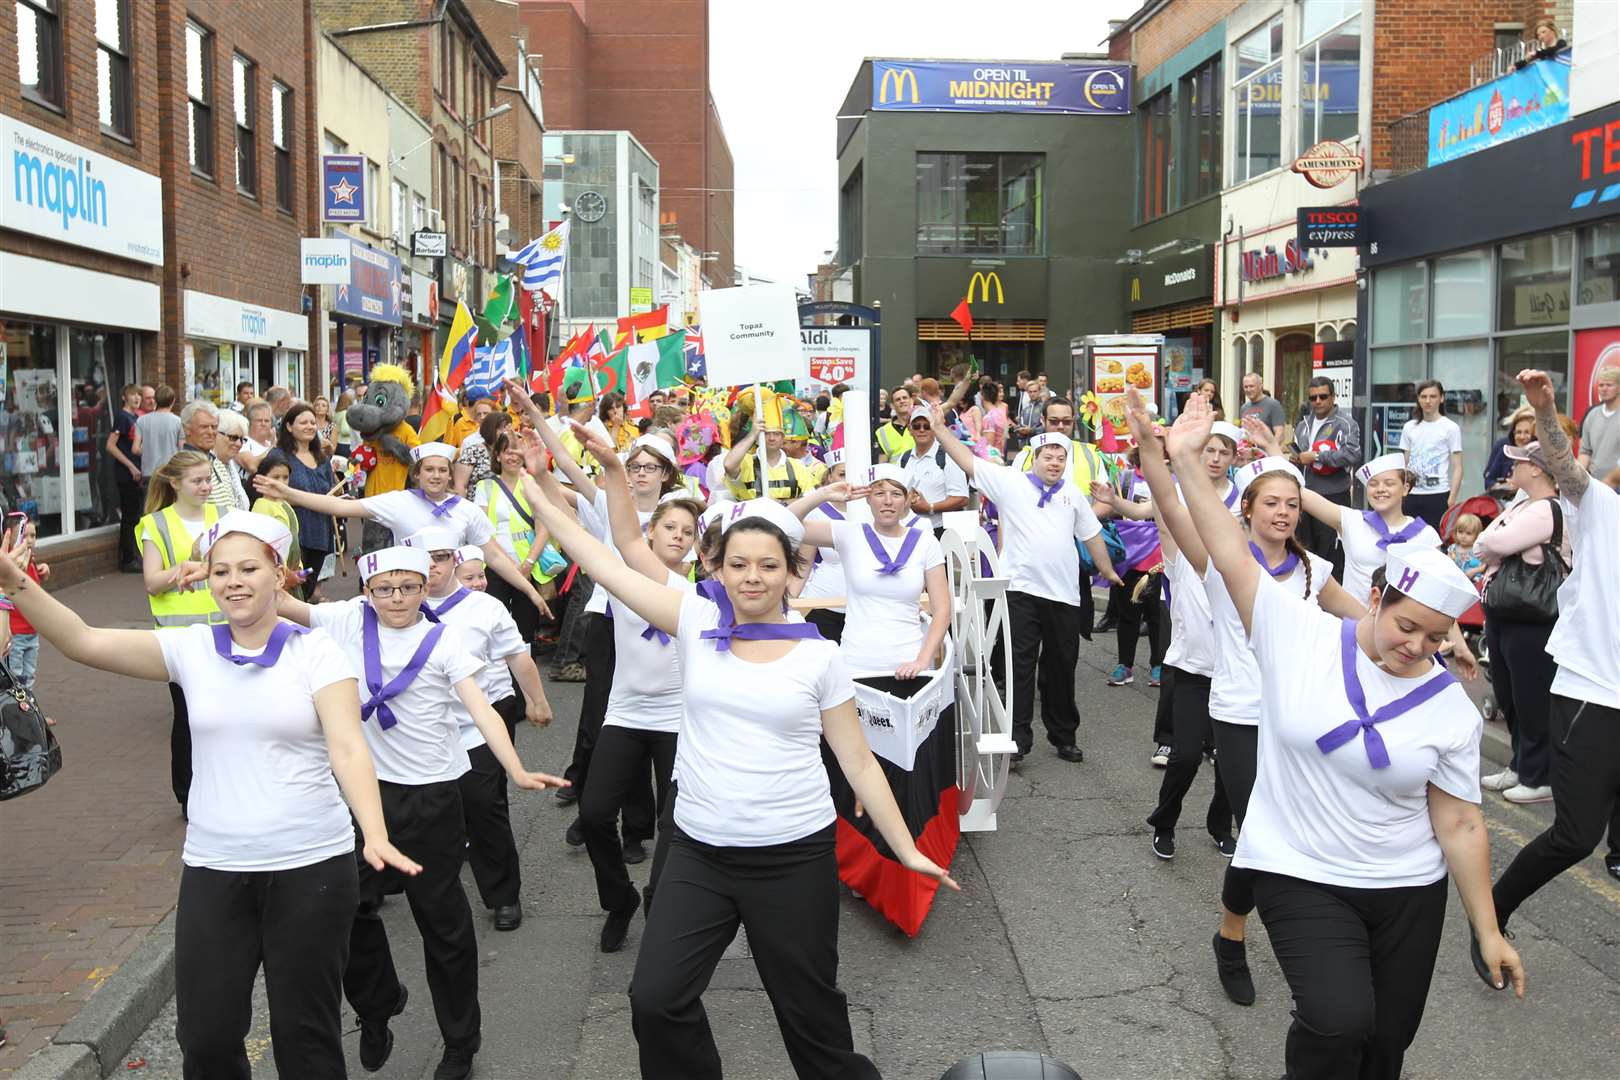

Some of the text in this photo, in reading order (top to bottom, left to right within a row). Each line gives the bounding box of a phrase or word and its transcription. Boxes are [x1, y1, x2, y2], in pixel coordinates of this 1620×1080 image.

[973, 68, 1031, 82] OPEN TIL
[949, 80, 1055, 99] MIDNIGHT
[14, 131, 77, 167] The electronics specialist
[1302, 160, 1357, 168] AMUSEMENTS
[14, 150, 107, 231] maplin
[1307, 212, 1358, 224] TESCO
[1309, 230, 1356, 243] express
[305, 254, 347, 268] maplin
[1164, 268, 1196, 286] McDonald's
[242, 312, 266, 337] maplin
[739, 322, 763, 330] Topaz
[730, 330, 775, 340] Community
[1341, 378, 1352, 398] LET
[1039, 434, 1046, 445] H
[414, 447, 420, 461] H
[833, 451, 841, 462] H
[868, 466, 876, 482] H
[1251, 460, 1264, 476] H
[1361, 465, 1372, 480] H
[731, 502, 746, 521] H
[208, 522, 220, 547] H
[698, 519, 708, 535] H
[366, 553, 378, 575] H
[1396, 567, 1420, 593] H
